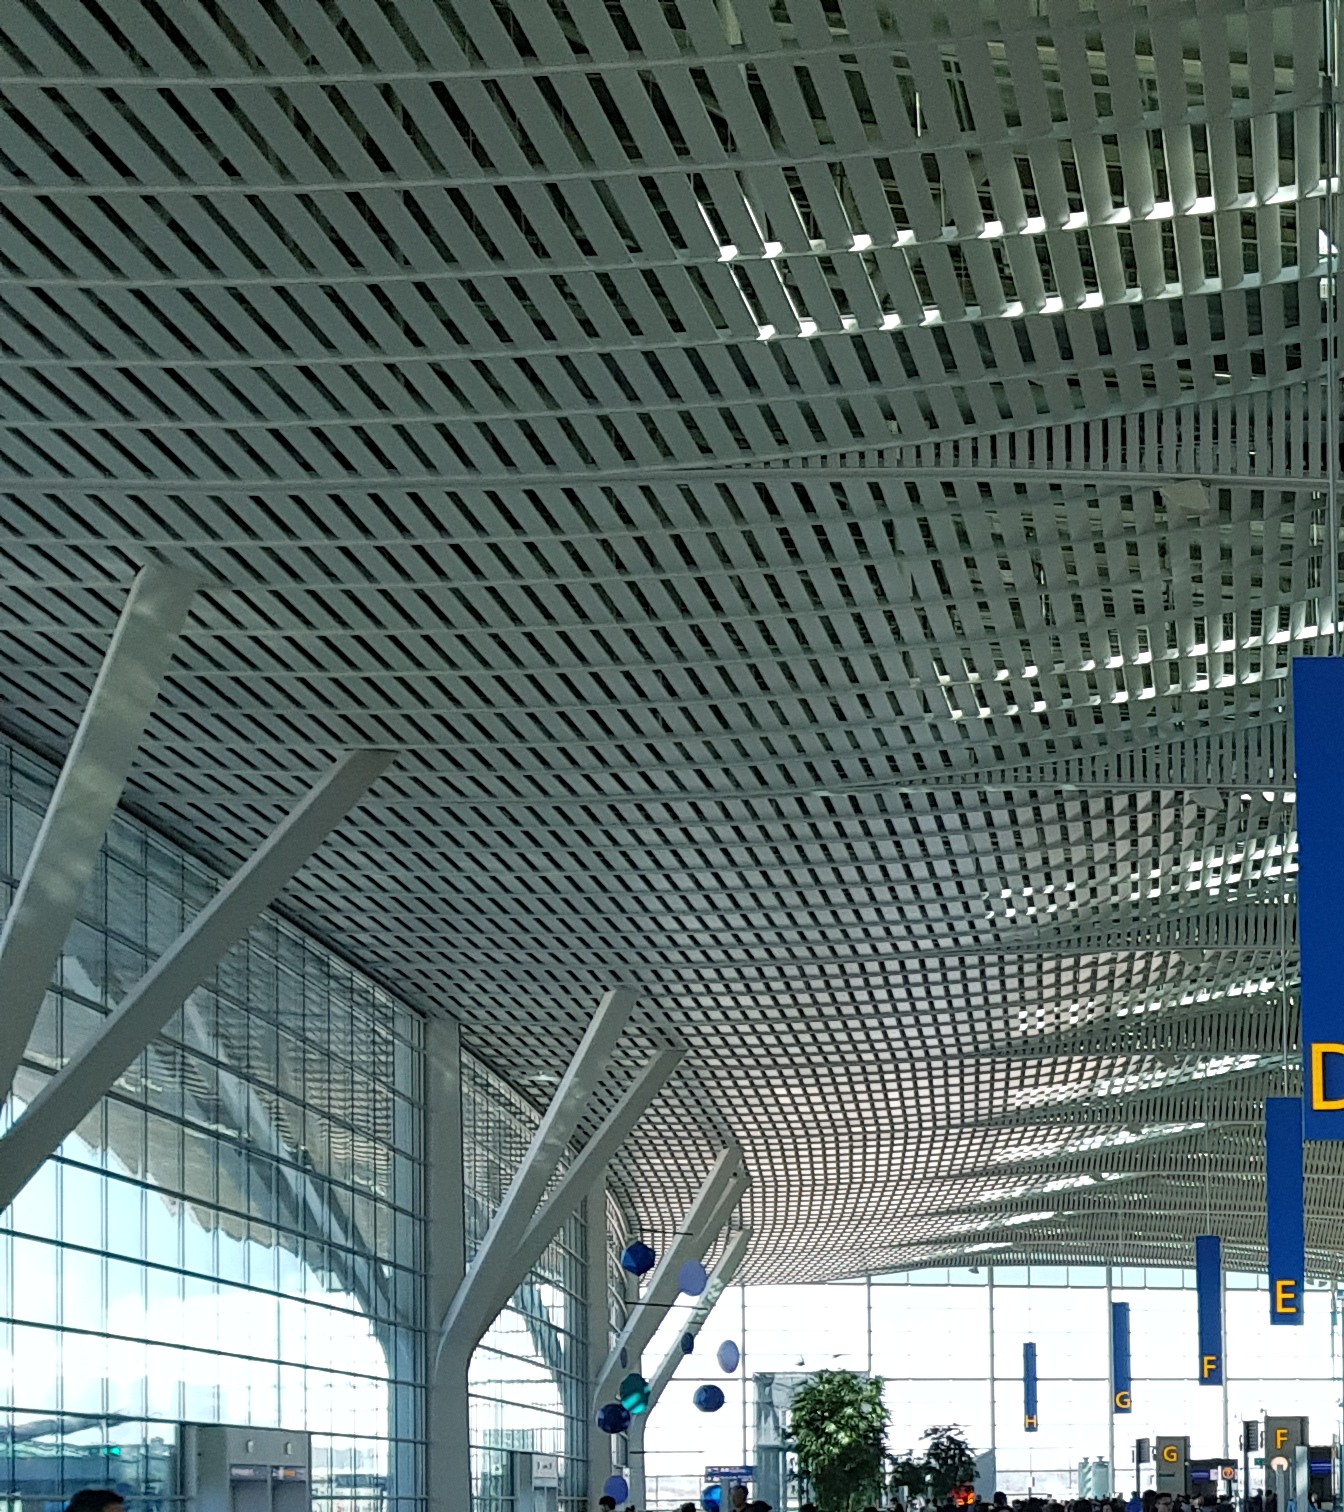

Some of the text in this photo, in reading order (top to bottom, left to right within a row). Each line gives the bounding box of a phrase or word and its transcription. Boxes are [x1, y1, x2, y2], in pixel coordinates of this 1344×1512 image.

[1275, 1279, 1298, 1313] E
[1203, 1356, 1217, 1378] F
[1115, 1391, 1131, 1409] G
[1024, 1414, 1037, 1428] H
[1275, 1429, 1289, 1449] F
[1163, 1446, 1178, 1463] G
